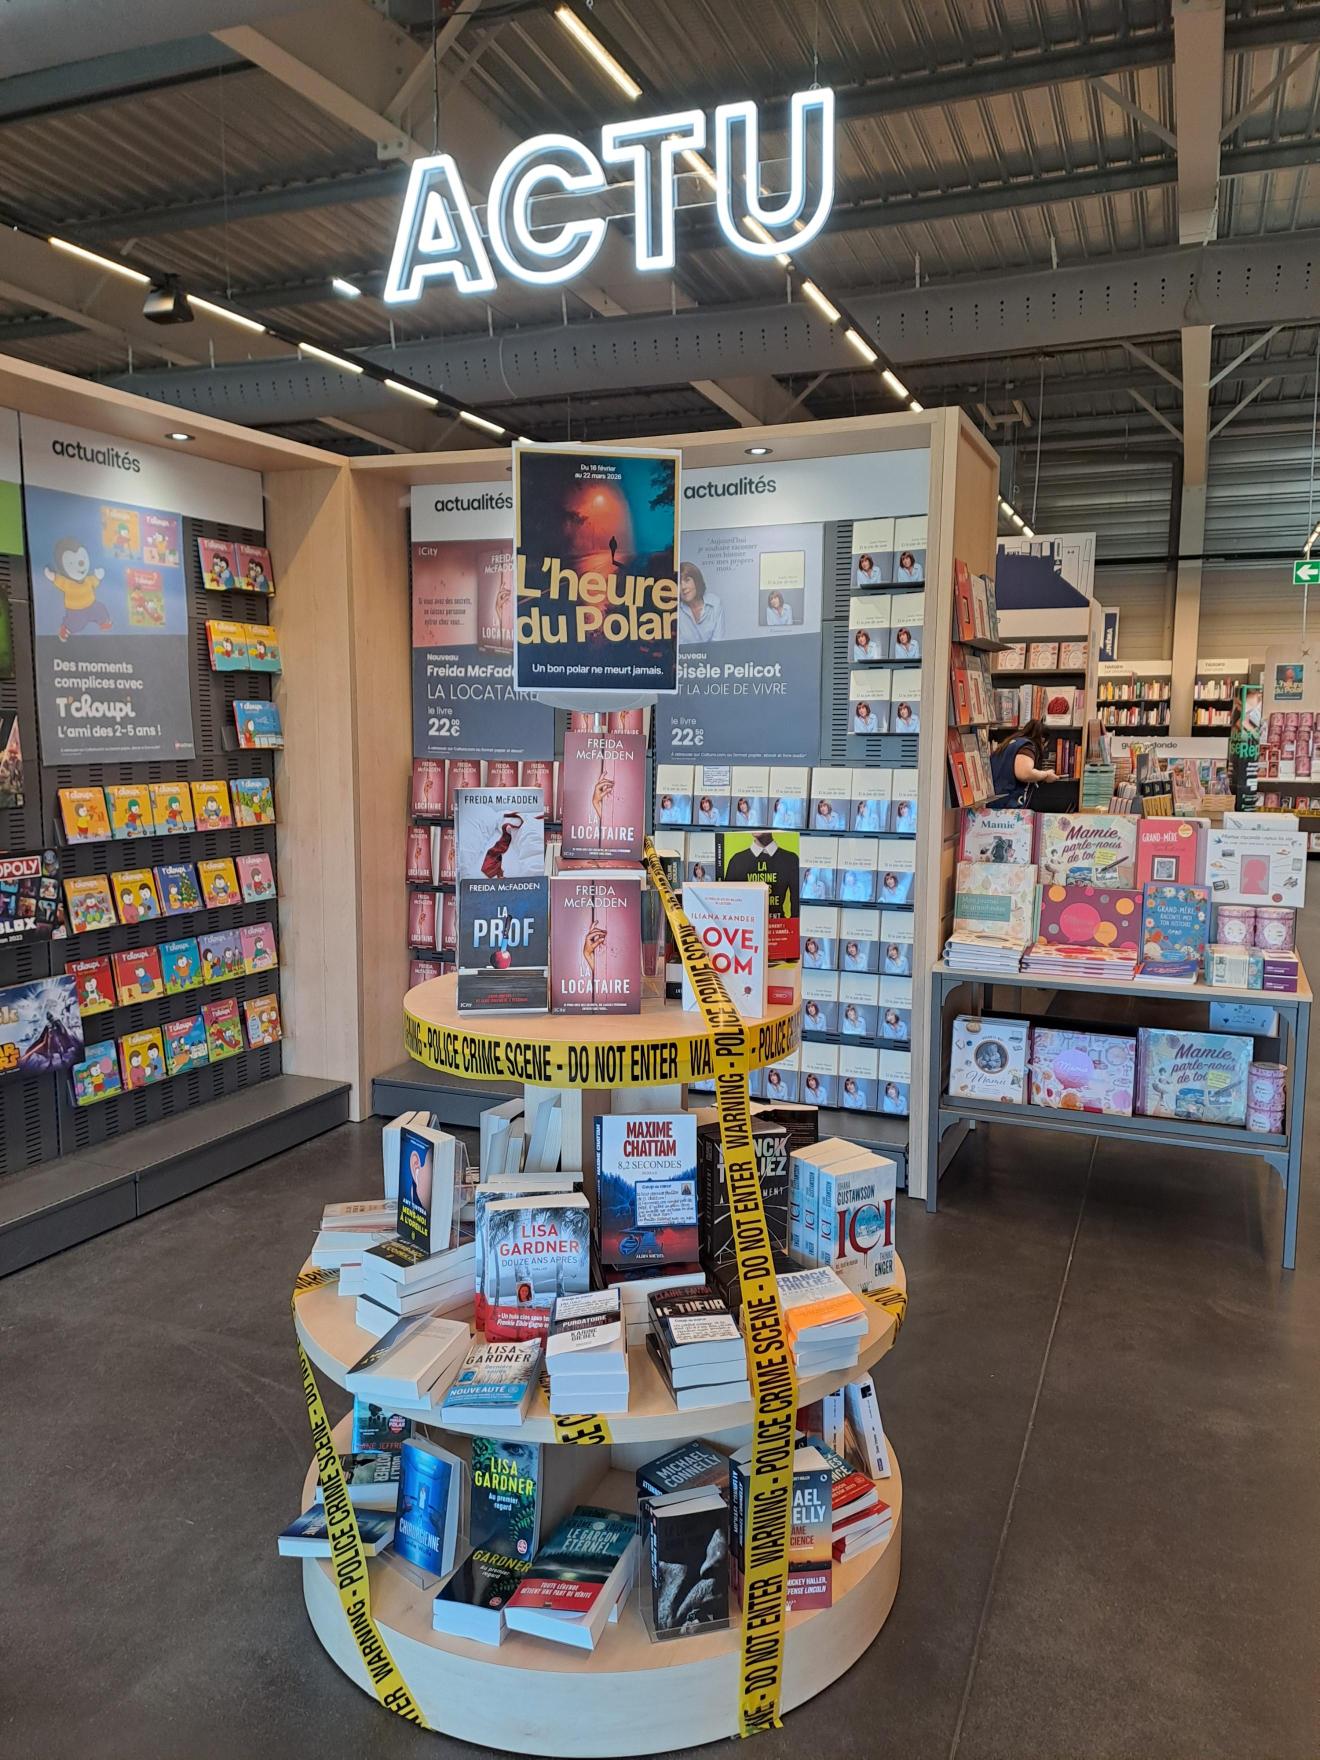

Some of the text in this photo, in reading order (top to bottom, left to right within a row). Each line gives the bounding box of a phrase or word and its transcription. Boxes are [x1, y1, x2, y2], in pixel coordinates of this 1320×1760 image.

[384, 87, 836, 304] ACTU
[52, 440, 141, 472] actualités
[580, 463, 590, 472] Du
[598, 464, 617, 472] février
[683, 475, 777, 500] actualités
[434, 492, 513, 512] actualités
[516, 554, 679, 610] L'heure
[517, 602, 679, 645] du Polar
[426, 653, 459, 662] Nouveau
[53, 659, 134, 674] Des moments
[426, 664, 465, 677] Freida
[532, 663, 664, 677] Un bon polar ne meurt jamais.
[724, 662, 782, 678] Pelicot
[54, 675, 144, 691] complices avec
[687, 682, 788, 695] LA JOIE DE VIVRE
[427, 684, 445, 700] LA
[55, 693, 137, 722] T'choupi
[427, 706, 453, 715] le livre
[671, 717, 697, 725] le livre
[57, 724, 157, 738] L'ami des 2-5 ans
[587, 738, 624, 749] FREIDA
[576, 750, 634, 761] McFADDEN
[464, 795, 539, 804] FREIDA McFADDEN
[981, 820, 1015, 829] Mamie
[571, 825, 635, 841] LOCATAIRE
[1066, 825, 1121, 842] Mamie,
[1142, 831, 1178, 843] GRAND-MÈRE
[1061, 840, 1122, 857] parle-nous
[757, 861, 767, 871] LA
[1067, 852, 1079, 864] de
[747, 872, 778, 883] VOISINE
[469, 882, 541, 892] FREIDA McFADDEN
[575, 885, 616, 896] FREIDA
[563, 897, 627, 908] McFADDEN
[497, 906, 508, 918] LA
[691, 912, 720, 921] ILIANA
[473, 917, 535, 948] PROF
[703, 926, 760, 953] OVE,
[711, 952, 753, 975] OM
[561, 979, 630, 994] LOCATAIRE
[706, 1006, 746, 1056] POLICE
[758, 1020, 786, 1063] POLICE
[427, 1026, 460, 1070] POLICE
[462, 1036, 504, 1075] CRIME
[505, 1042, 552, 1081] SCENE
[568, 1045, 590, 1083] DO
[595, 1045, 627, 1083] NOT
[631, 1043, 679, 1081] ENTER
[1176, 1043, 1236, 1062] Mamie,
[1171, 1061, 1236, 1079] parle-nous
[626, 1121, 673, 1139] MAXIME
[623, 1139, 677, 1157] CHATTAM
[617, 1159, 682, 1170] 8,2 SECONDES
[717, 1073, 771, 1281] WARNING ENTER NOT DO
[837, 1184, 875, 1206] GUSTAWSSON
[521, 1223, 559, 1239] LISA
[836, 1198, 894, 1260] ICI
[500, 1240, 579, 1257] GARDNER
[501, 1255, 578, 1267] DOUZE ANS APRÈS
[874, 1260, 893, 1277] ENGER
[777, 1270, 830, 1284] FRANCK
[487, 1345, 517, 1355] LISA
[466, 1353, 532, 1365] GARDNER
[450, 1385, 506, 1397] NOUVEAUTÉ
[747, 1295, 793, 1476] SCENE CRIME POLICE
[490, 1457, 518, 1476] LISA
[656, 1450, 709, 1479] MICHAEL
[664, 1453, 721, 1488] CONNELLY
[474, 1470, 534, 1496] GARDNER
[488, 1492, 518, 1505] Au premier
[494, 1502, 512, 1512] regard
[303, 1381, 394, 1685] DO SCENE CRIME POLICE WARNING
[567, 1528, 581, 1538] LE
[750, 1484, 789, 1569] WARNING
[399, 1517, 441, 1553] CHIRURGIENNE
[472, 1550, 533, 1573] GARDNER
[540, 1582, 579, 1590] TOUTE LÉGENDE
[806, 1577, 828, 1587] HALLER,
[542, 1588, 553, 1596] UNE
[553, 1589, 566, 1597] PART
[567, 1590, 574, 1598] DE
[747, 1573, 784, 1632] ENTER
[745, 1628, 780, 1667] NOT
[744, 1664, 778, 1695] DO
